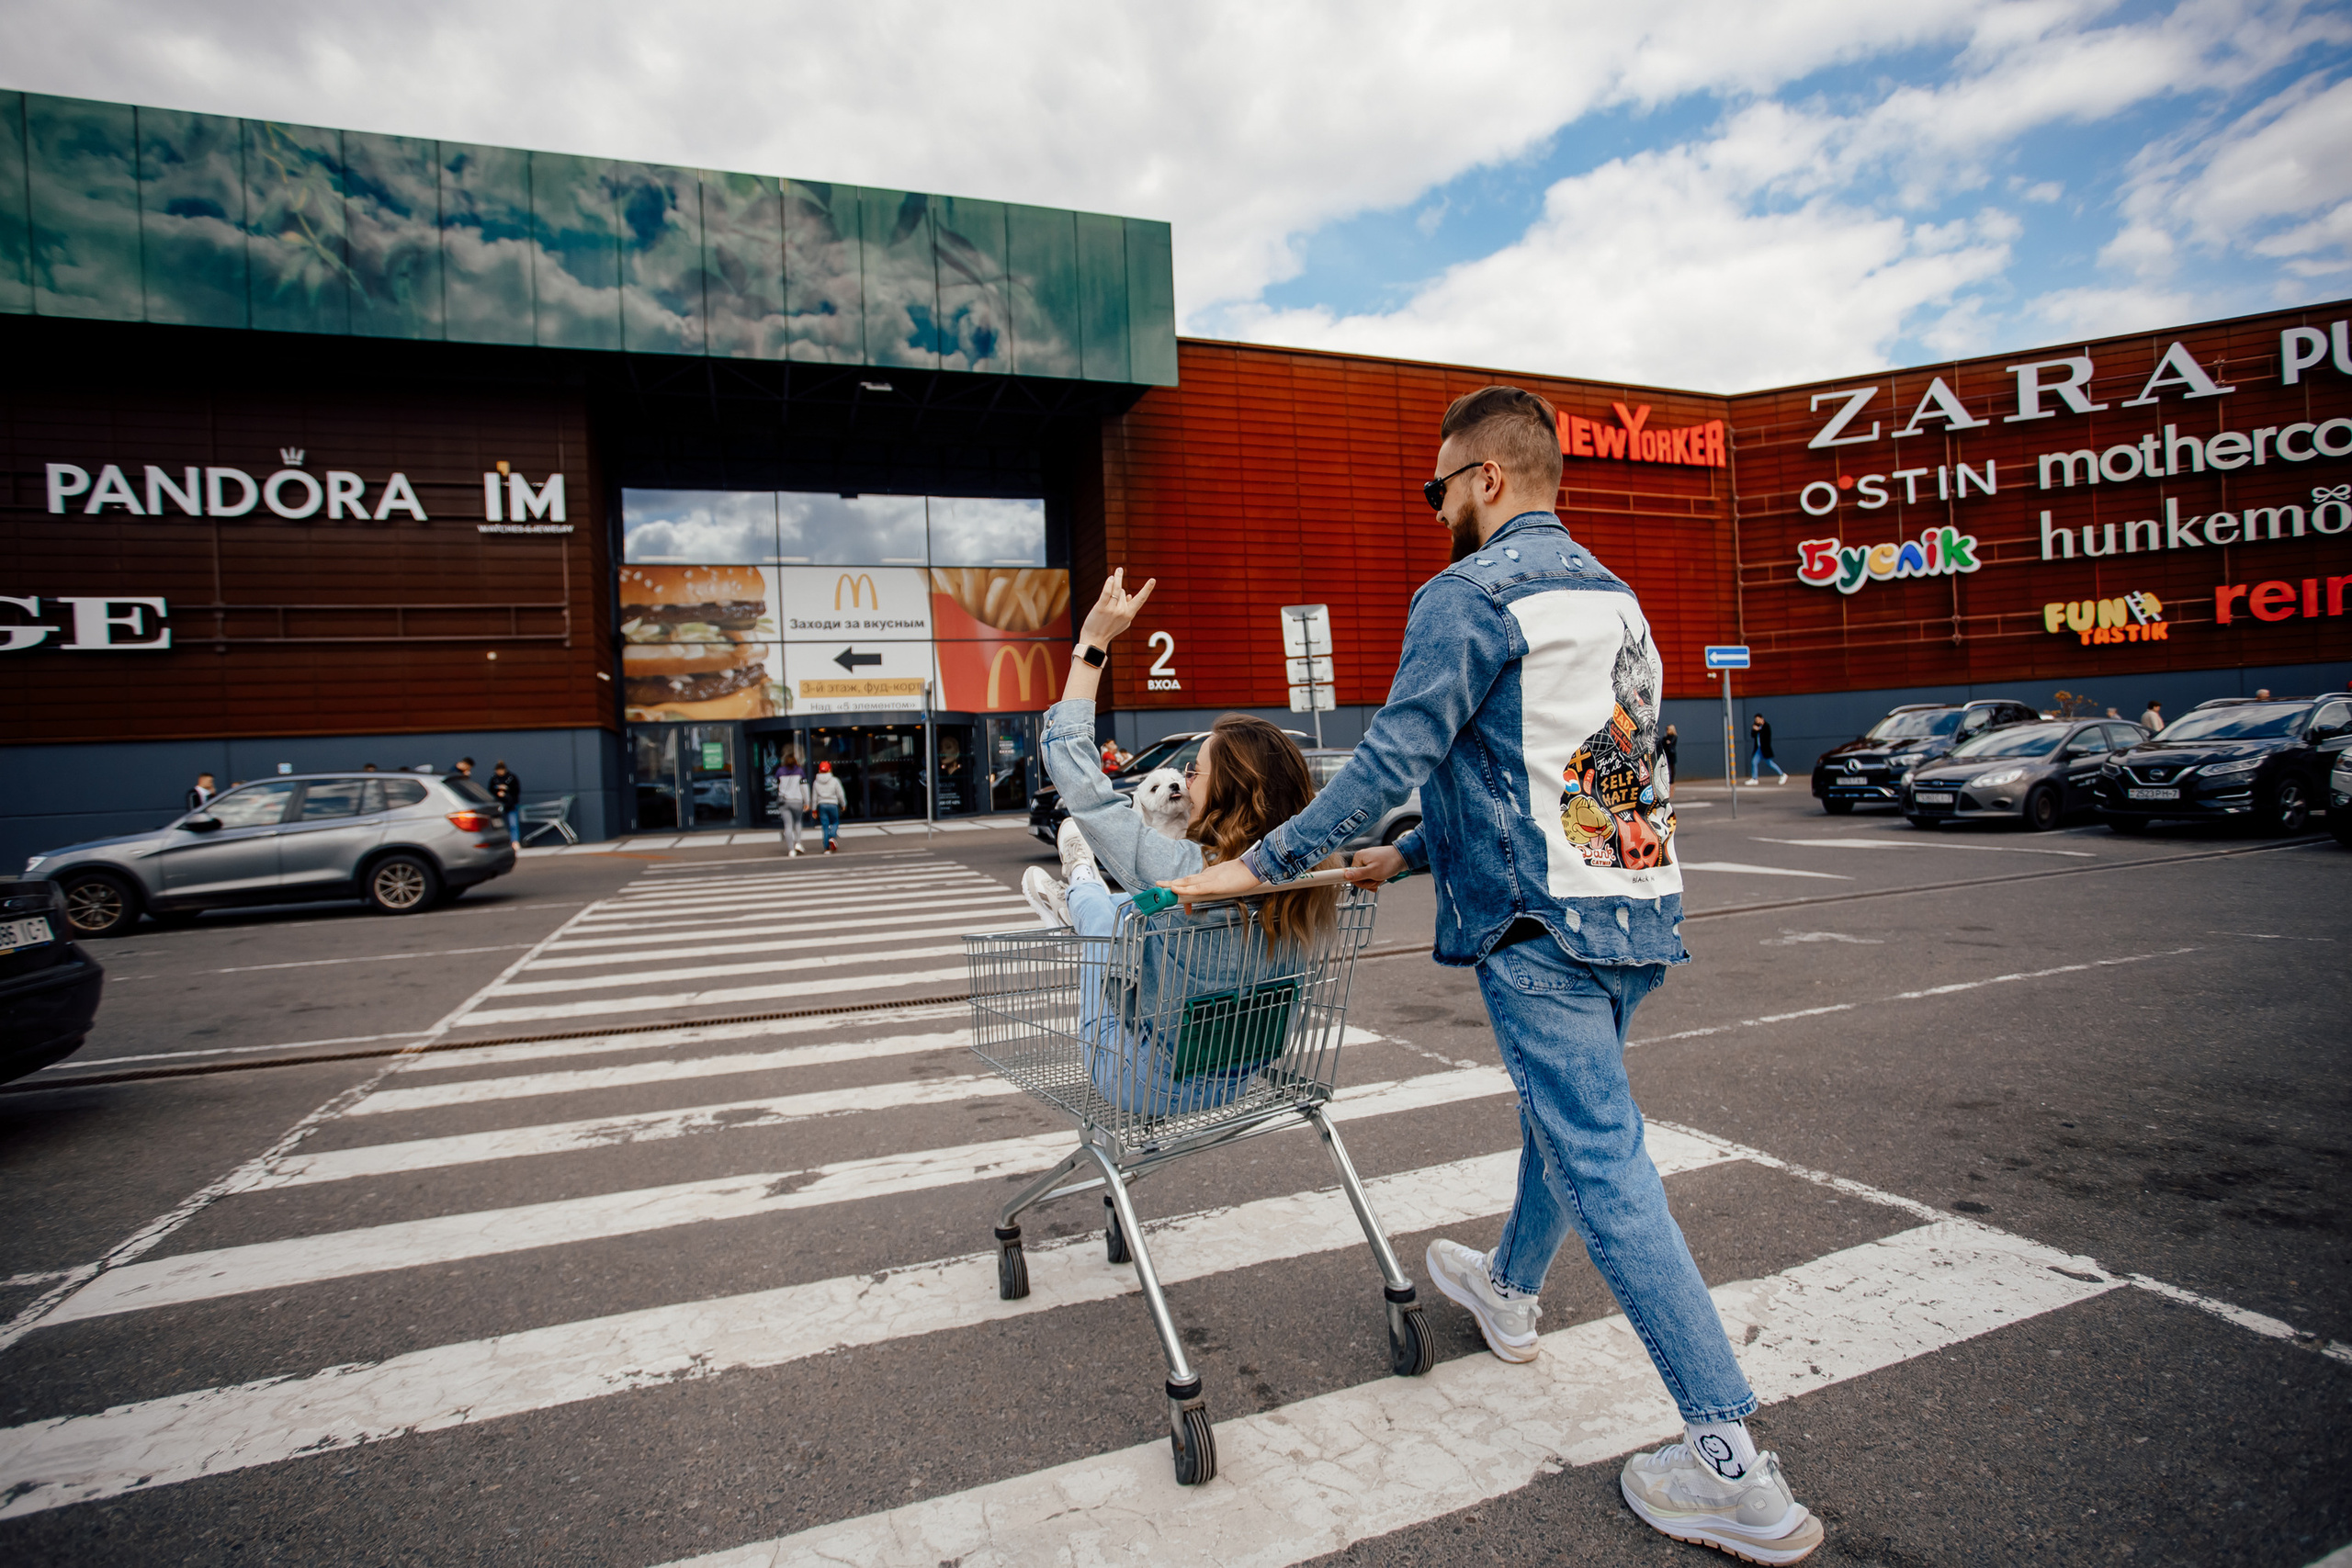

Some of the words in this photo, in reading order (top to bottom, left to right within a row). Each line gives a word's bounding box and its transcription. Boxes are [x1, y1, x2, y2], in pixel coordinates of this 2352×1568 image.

[1808, 341, 2236, 449] ZARA
[46, 462, 428, 523] PANDORA
[790, 618, 841, 630] Заходи
[845, 620, 860, 628] за
[864, 619, 924, 631] вкусным
[2043, 597, 2129, 634] FUN
[2077, 621, 2169, 646] TASTIK
[1148, 631, 1176, 676] 2
[802, 682, 823, 694] 3-й
[828, 682, 861, 694] этаж,
[1148, 679, 1182, 691] ВХОД
[810, 703, 831, 712] Над
[1613, 705, 1631, 730] BAD
[1600, 770, 1634, 793] SELF
[1601, 786, 1639, 807] HATE
[1577, 844, 1616, 861] Dank
